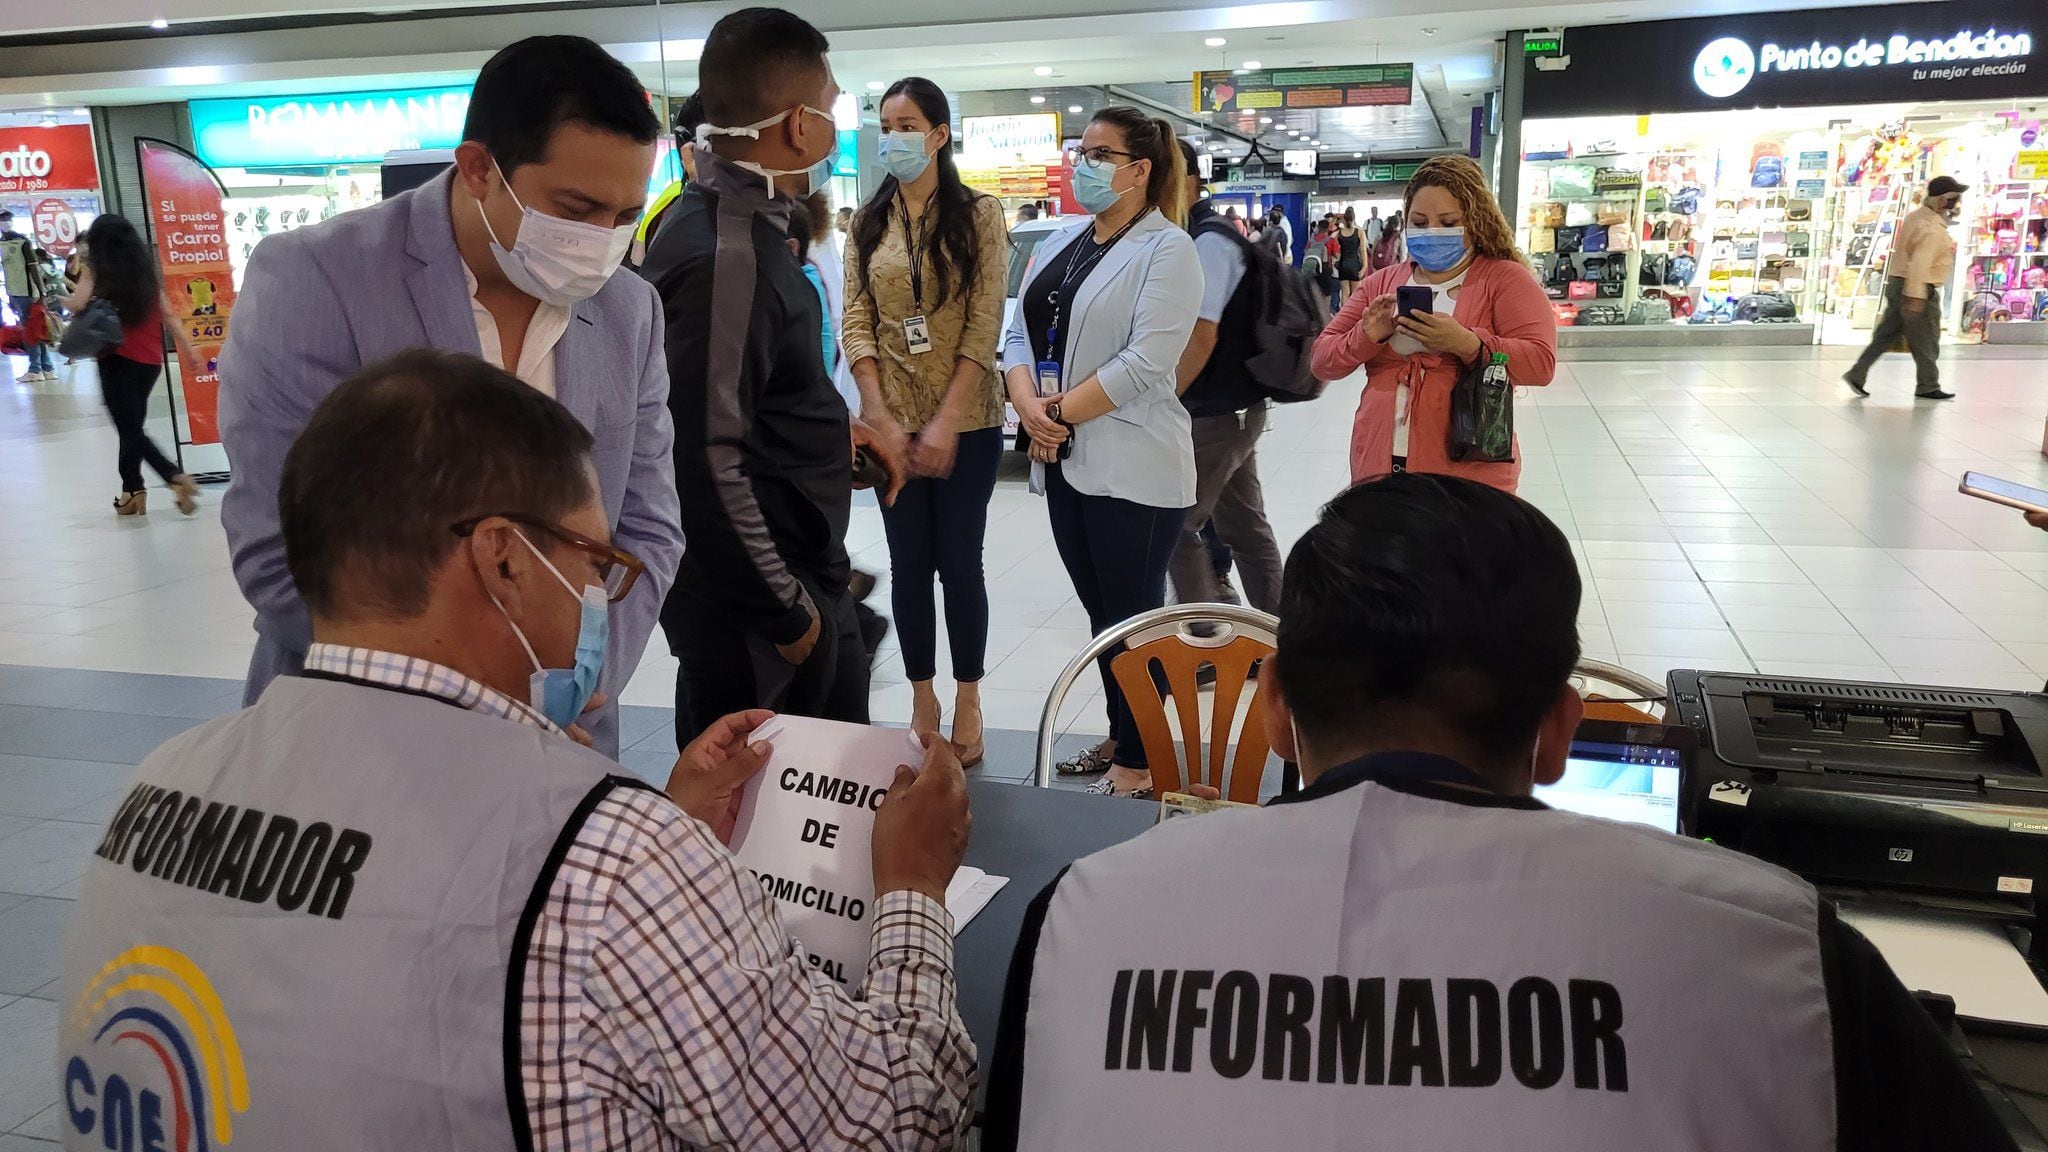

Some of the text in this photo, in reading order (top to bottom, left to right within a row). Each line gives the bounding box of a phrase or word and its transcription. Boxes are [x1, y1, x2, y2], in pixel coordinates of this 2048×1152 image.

[1525, 42, 1557, 51] SALIDA
[1761, 43, 1842, 72] Punto
[1844, 39, 1885, 67] de
[1913, 61, 2026, 80] tu mejor elección
[0, 144, 51, 177] ato
[26, 178, 49, 191] 1980
[35, 212, 76, 244] 50
[163, 211, 218, 223] se puede
[194, 223, 220, 231] tener
[167, 231, 221, 249] ¡Carro
[169, 248, 224, 264] Propio!
[204, 325, 223, 337] 40
[780, 767, 888, 812] CAMBIO
[801, 818, 840, 849] DE
[95, 781, 373, 920] INFORMADOR
[748, 869, 865, 922] OMICILIO
[1104, 969, 1629, 1092] INFORMADOR
